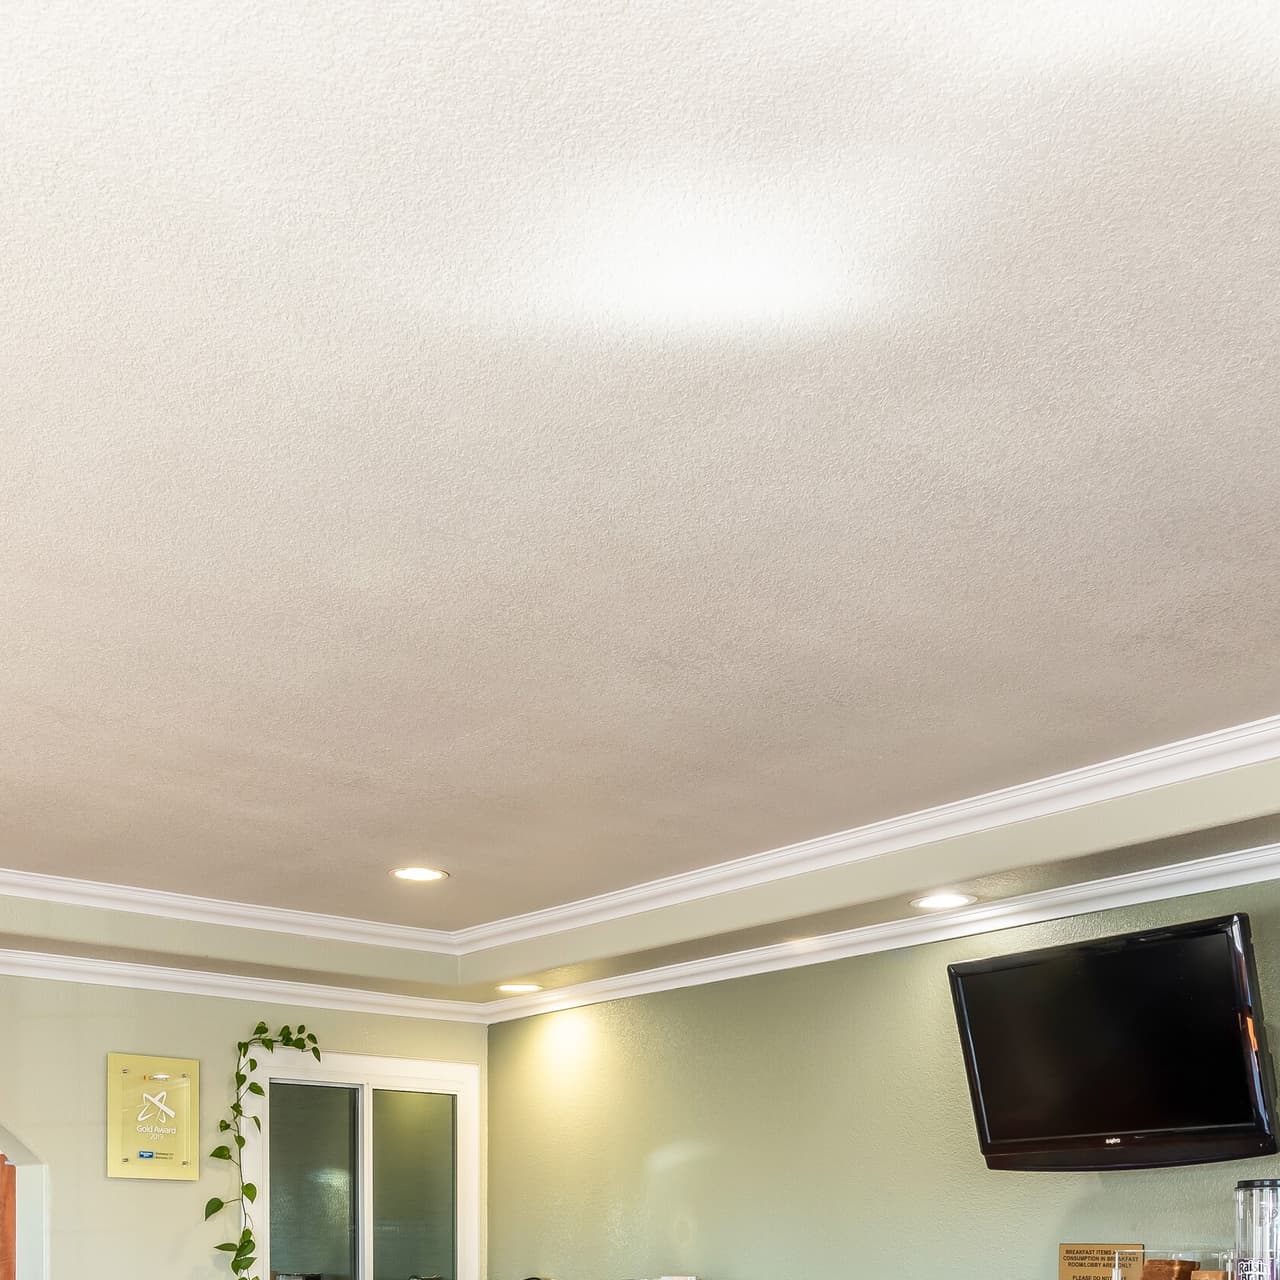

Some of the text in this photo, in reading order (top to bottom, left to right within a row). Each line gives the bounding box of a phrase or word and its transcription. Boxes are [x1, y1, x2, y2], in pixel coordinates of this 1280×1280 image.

[136, 1125, 177, 1135] Gold Award
[1239, 1260, 1270, 1273] Raisin
